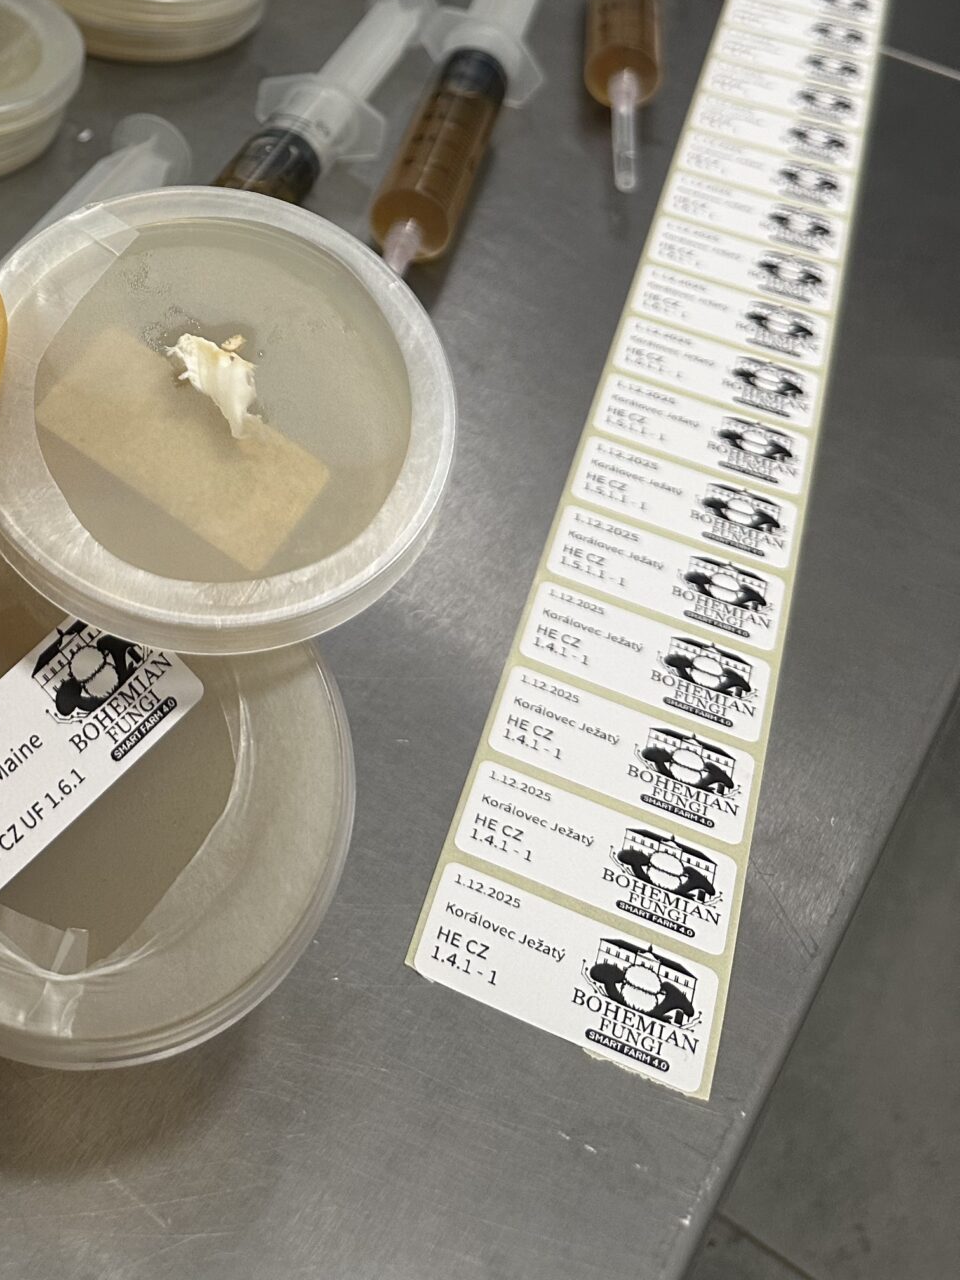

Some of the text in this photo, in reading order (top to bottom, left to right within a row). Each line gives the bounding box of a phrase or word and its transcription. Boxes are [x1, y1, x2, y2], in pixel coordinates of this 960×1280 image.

[575, 513, 639, 542] 1.12.2025
[562, 544, 605, 566] HE CZ
[549, 589, 605, 615] 1.12.2025
[672, 586, 772, 629] BOHEMIAN
[533, 637, 567, 657] 1.4.1
[581, 655, 588, 665] 1
[537, 624, 581, 648] HE CZ
[69, 652, 172, 753] BOHEMIAN
[521, 675, 580, 703] 1.12.2025
[651, 670, 756, 717] BOHEMIAN
[675, 690, 727, 716] FUNGI
[105, 689, 161, 744] FUNGI
[114, 700, 175, 758] SMART FARM 4.0
[507, 714, 554, 741] HE CZ
[514, 696, 620, 745] Korálovec Ježatý
[503, 728, 538, 751] 1.4.1
[554, 748, 561, 760] 1
[20, 802, 43, 829] UF
[44, 768, 86, 809] 1.6.1
[489, 770, 552, 801] 1.12.2025
[627, 764, 739, 816] BOHEMIAN
[652, 787, 708, 816] FUNGI
[475, 813, 524, 842] HE CZ
[482, 794, 595, 847] Korálovec Ježatý
[470, 828, 507, 853] 1.4.1
[524, 850, 532, 862] 1
[454, 874, 520, 908] 1.12.2025
[602, 867, 721, 926] BOHEMIAN
[629, 891, 688, 925] FUNGI
[446, 902, 566, 962] Korálovec Ježatý
[620, 902, 651, 919] SMART
[652, 915, 678, 930] FARM
[437, 926, 489, 960] HE CZ
[431, 946, 470, 974] 1.4.1
[488, 970, 496, 986] 1
[572, 987, 699, 1054] BOHEMIAN
[600, 1017, 663, 1055] FUNGI
[589, 1032, 666, 1070] SMART FARM 4.0
